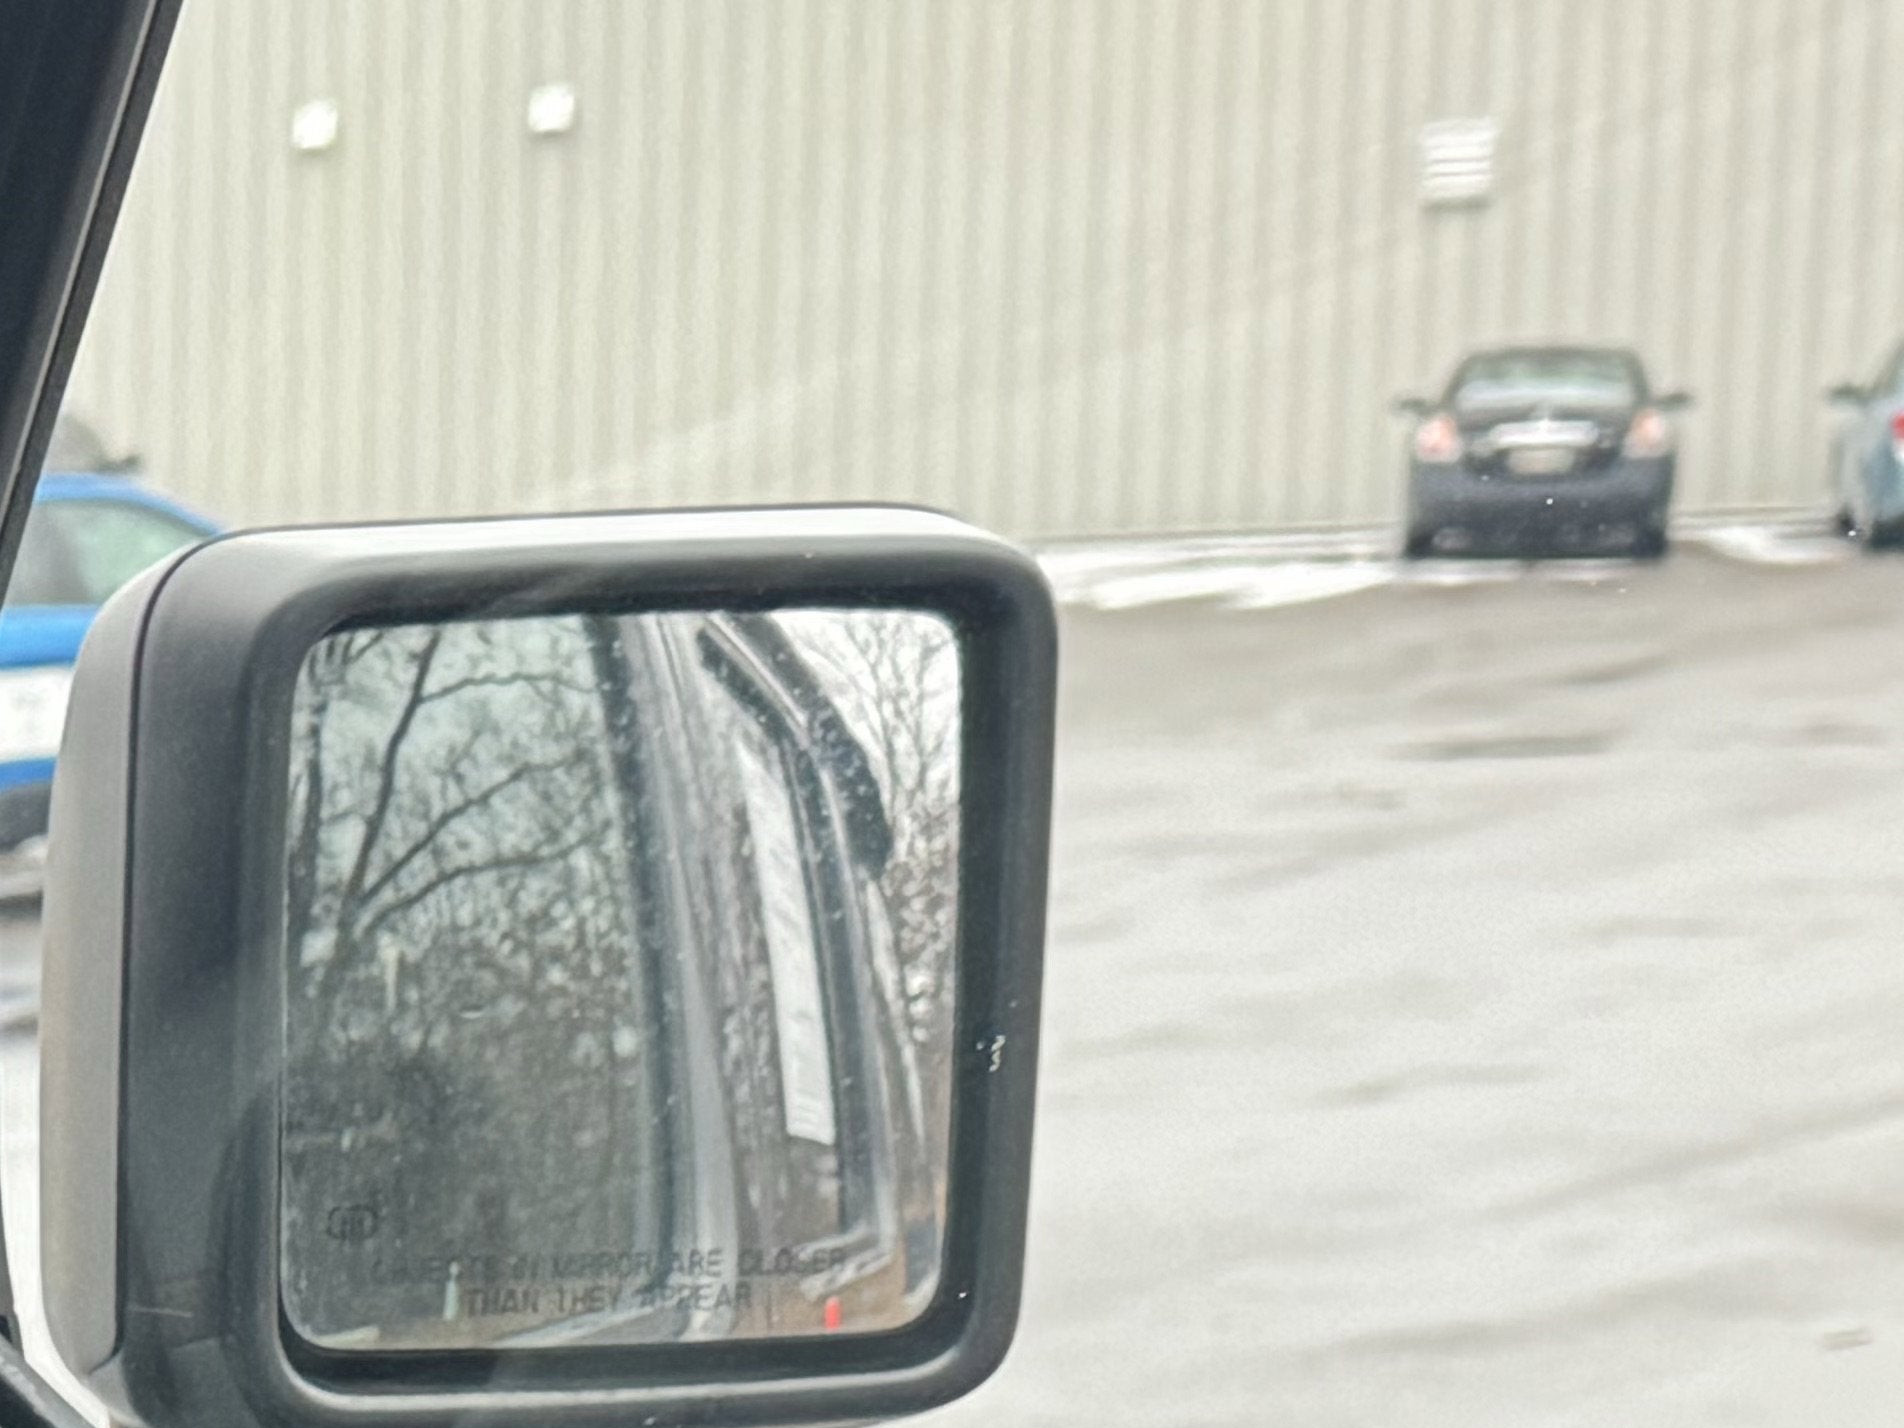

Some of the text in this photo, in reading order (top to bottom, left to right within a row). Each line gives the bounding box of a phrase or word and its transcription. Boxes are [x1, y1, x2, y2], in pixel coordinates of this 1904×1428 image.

[551, 1251, 654, 1280] MIRROR
[669, 1247, 722, 1279] ARE
[464, 1286, 539, 1318] THAN
[553, 1281, 624, 1316] THEY
